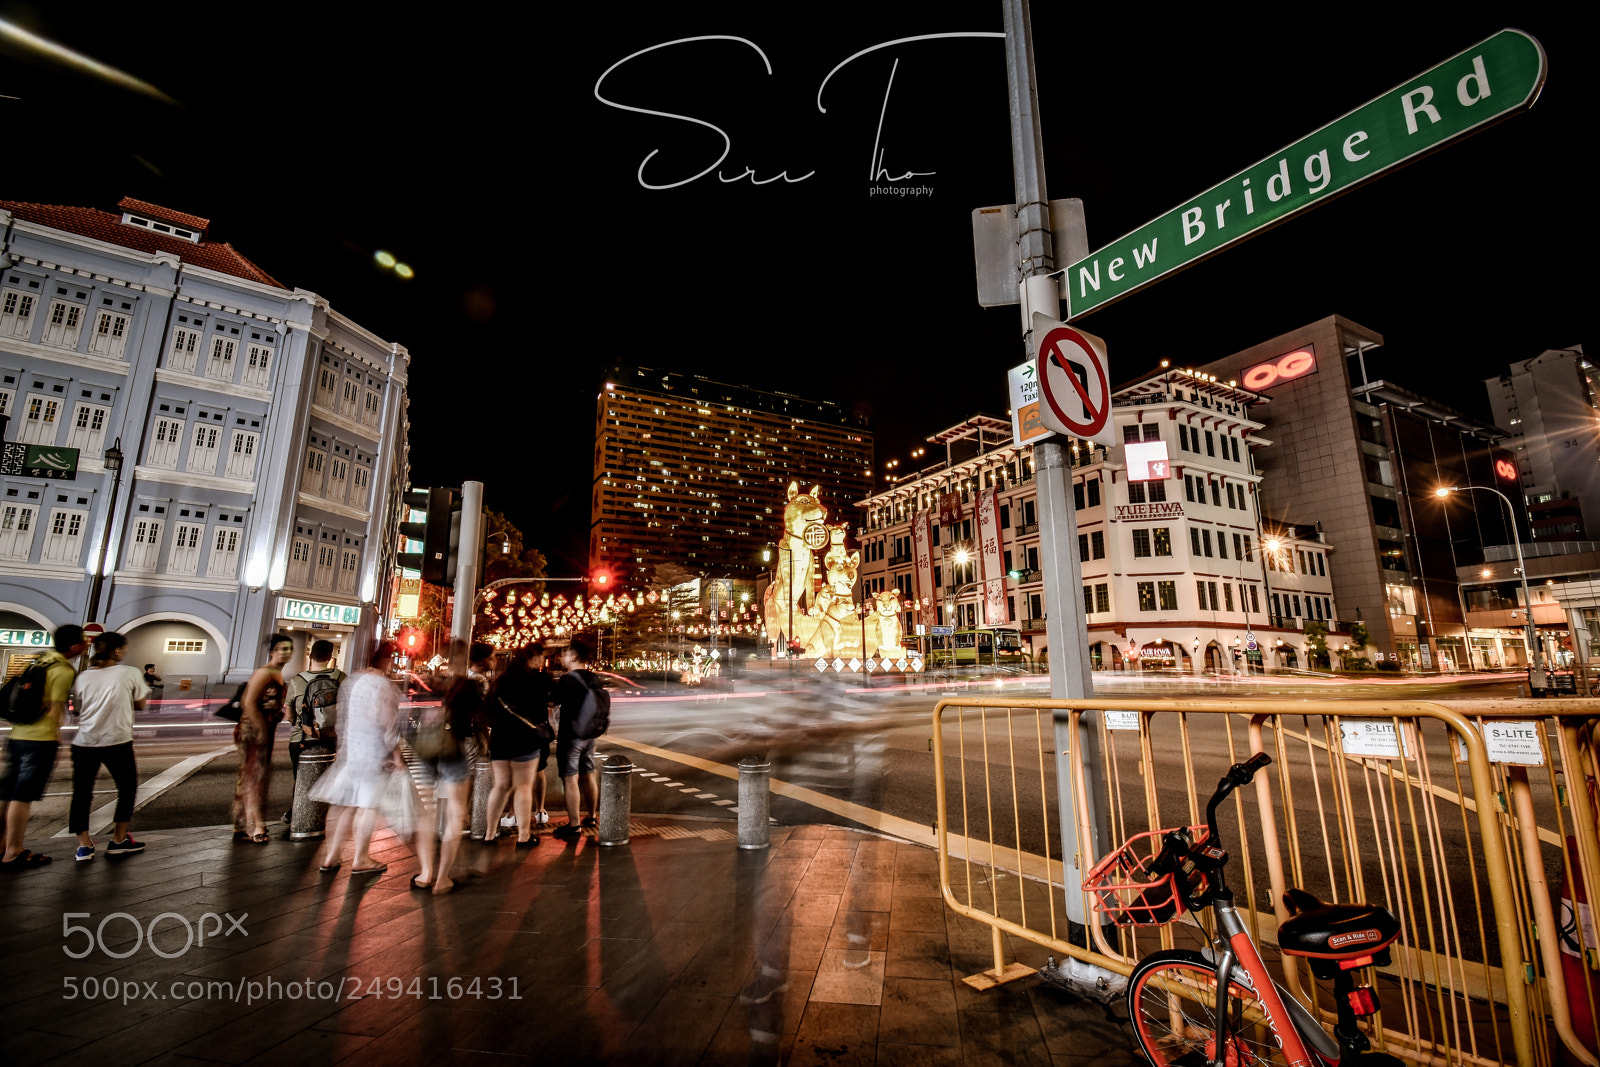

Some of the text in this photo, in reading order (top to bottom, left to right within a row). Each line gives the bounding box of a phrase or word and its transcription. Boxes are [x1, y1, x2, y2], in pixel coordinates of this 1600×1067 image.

[1079, 54, 1492, 298] New Bridge Rd
[1244, 351, 1313, 388] OG
[1564, 439, 1579, 449] 34
[1116, 502, 1184, 516] YUE HWA
[805, 525, 826, 547] 福
[983, 537, 997, 556] 福
[918, 553, 929, 569] 福
[289, 601, 359, 623] HOTEL 81
[30, 630, 51, 646] 81
[1492, 729, 1535, 738] S-LITE
[1332, 936, 1347, 944] Scan
[1352, 932, 1366, 940] Ride
